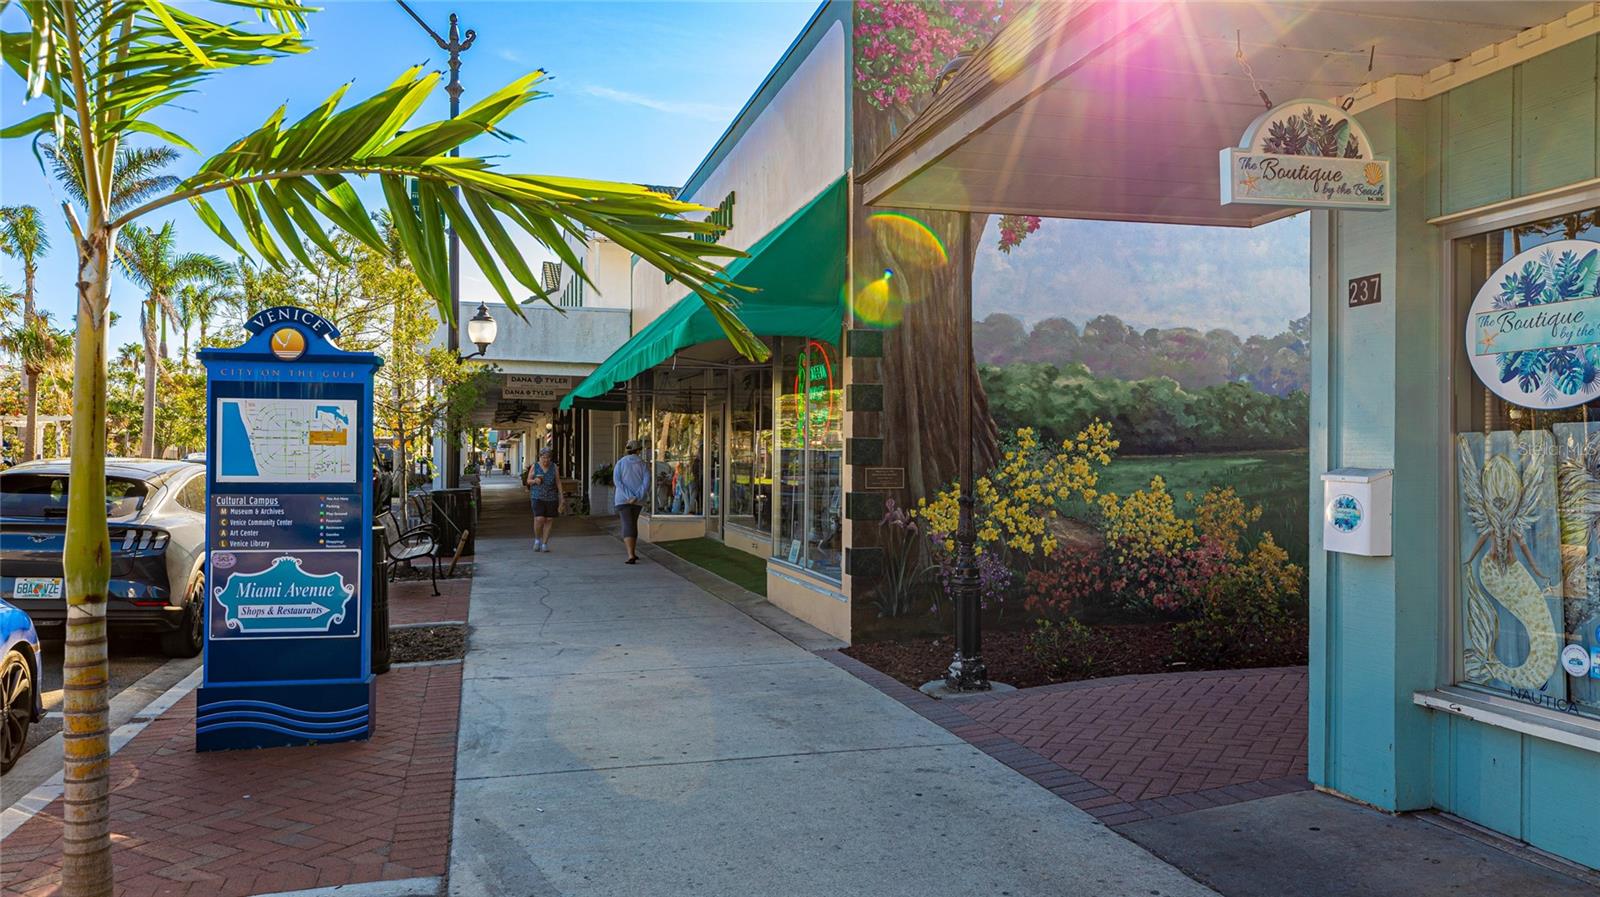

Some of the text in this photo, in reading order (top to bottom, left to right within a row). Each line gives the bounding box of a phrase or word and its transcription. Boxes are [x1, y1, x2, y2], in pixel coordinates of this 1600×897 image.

[1238, 157, 1343, 193] The Boutique
[1322, 183, 1385, 199] by the Beach
[1350, 277, 1380, 304] 237
[253, 308, 325, 332] VENICE
[1478, 314, 1496, 328] The
[1496, 310, 1585, 338] Boutique
[1560, 325, 1573, 344] by
[1576, 323, 1595, 337] the
[220, 368, 252, 377] CITY
[261, 369, 280, 377] ON
[216, 496, 279, 507] Cultural Campus
[260, 507, 285, 515] Archives
[247, 519, 276, 527] Community
[250, 540, 270, 548] Library
[236, 582, 335, 598] Miami Avenue
[241, 606, 323, 617] Shops & Restaurants
[1510, 686, 1580, 715] NAUTICA
